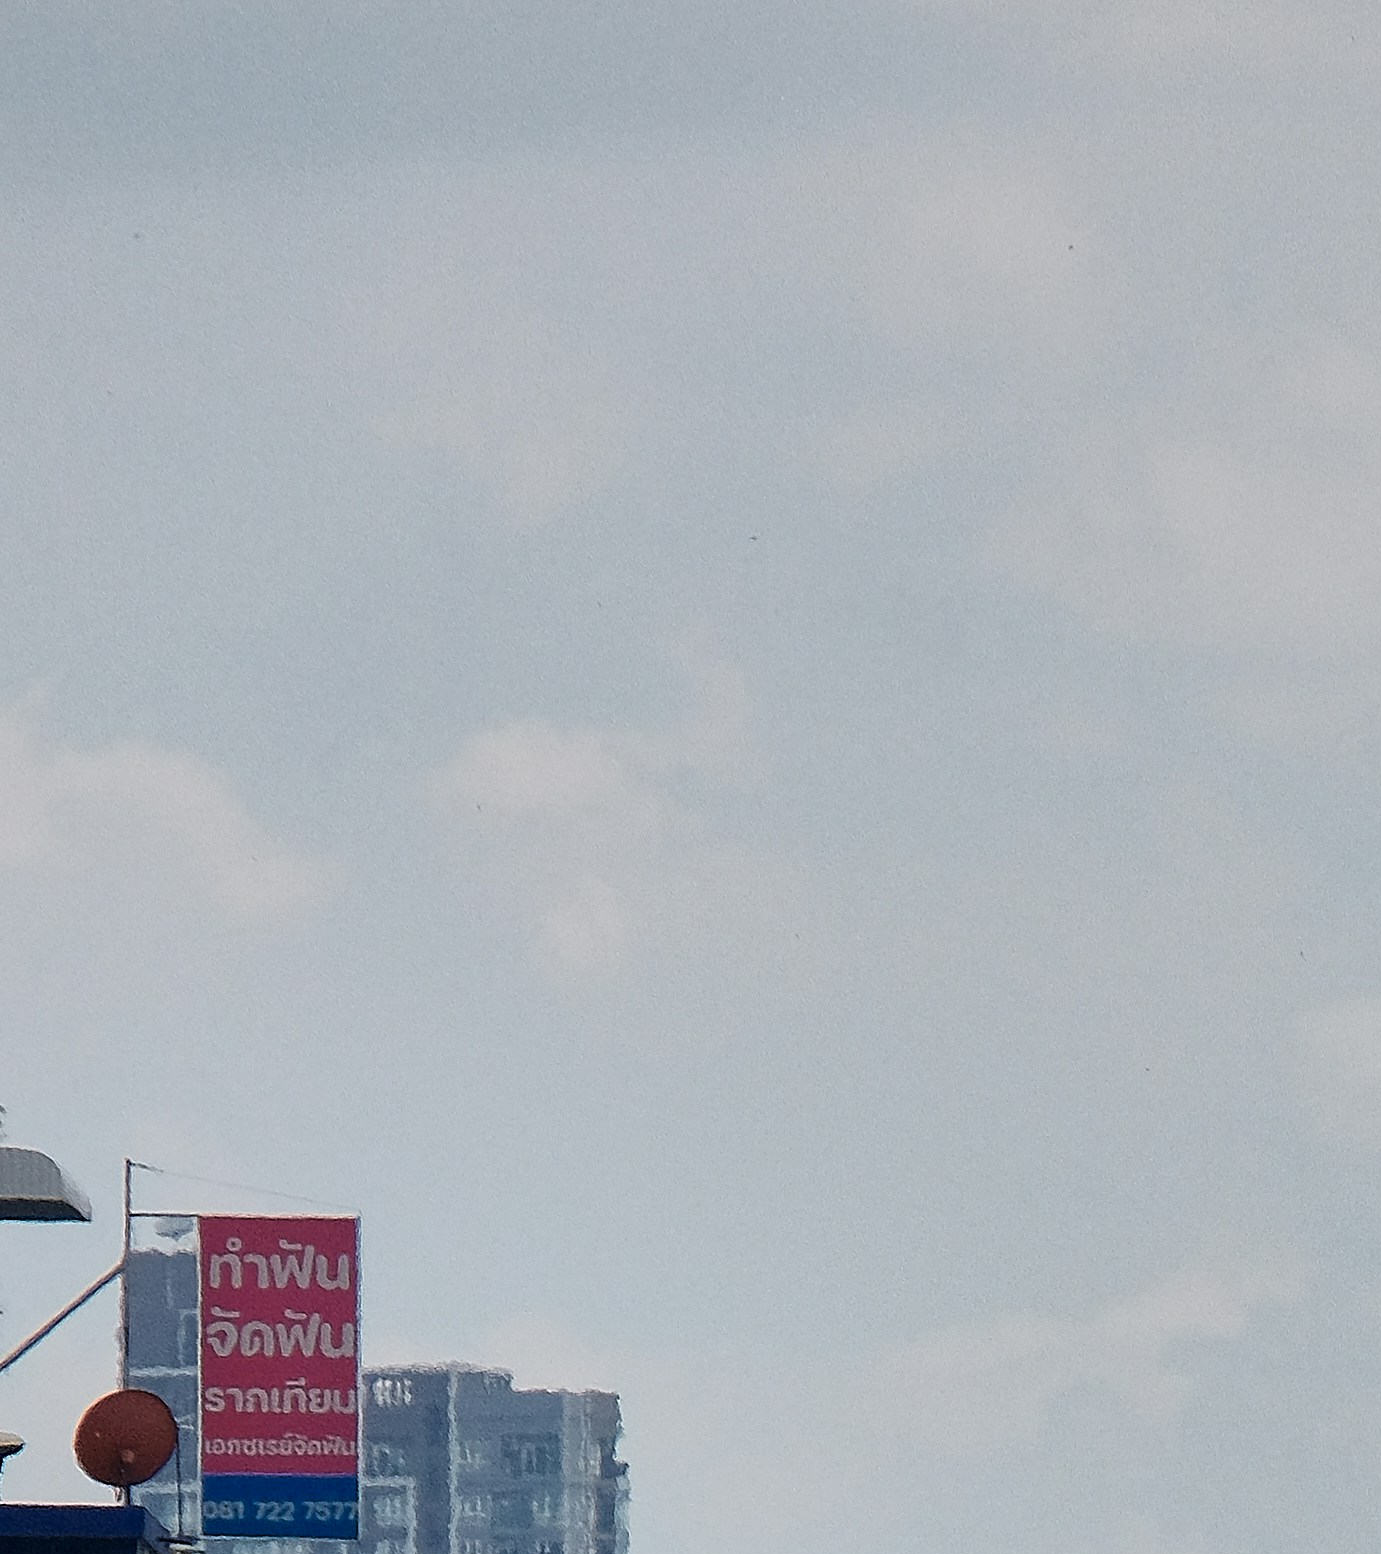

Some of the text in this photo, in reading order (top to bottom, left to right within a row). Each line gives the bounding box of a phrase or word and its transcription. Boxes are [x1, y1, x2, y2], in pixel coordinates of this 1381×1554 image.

[208, 1237, 351, 1291] ทำฟัน
[205, 1306, 355, 1359] จัดฟัน
[254, 1500, 295, 1521] 722
